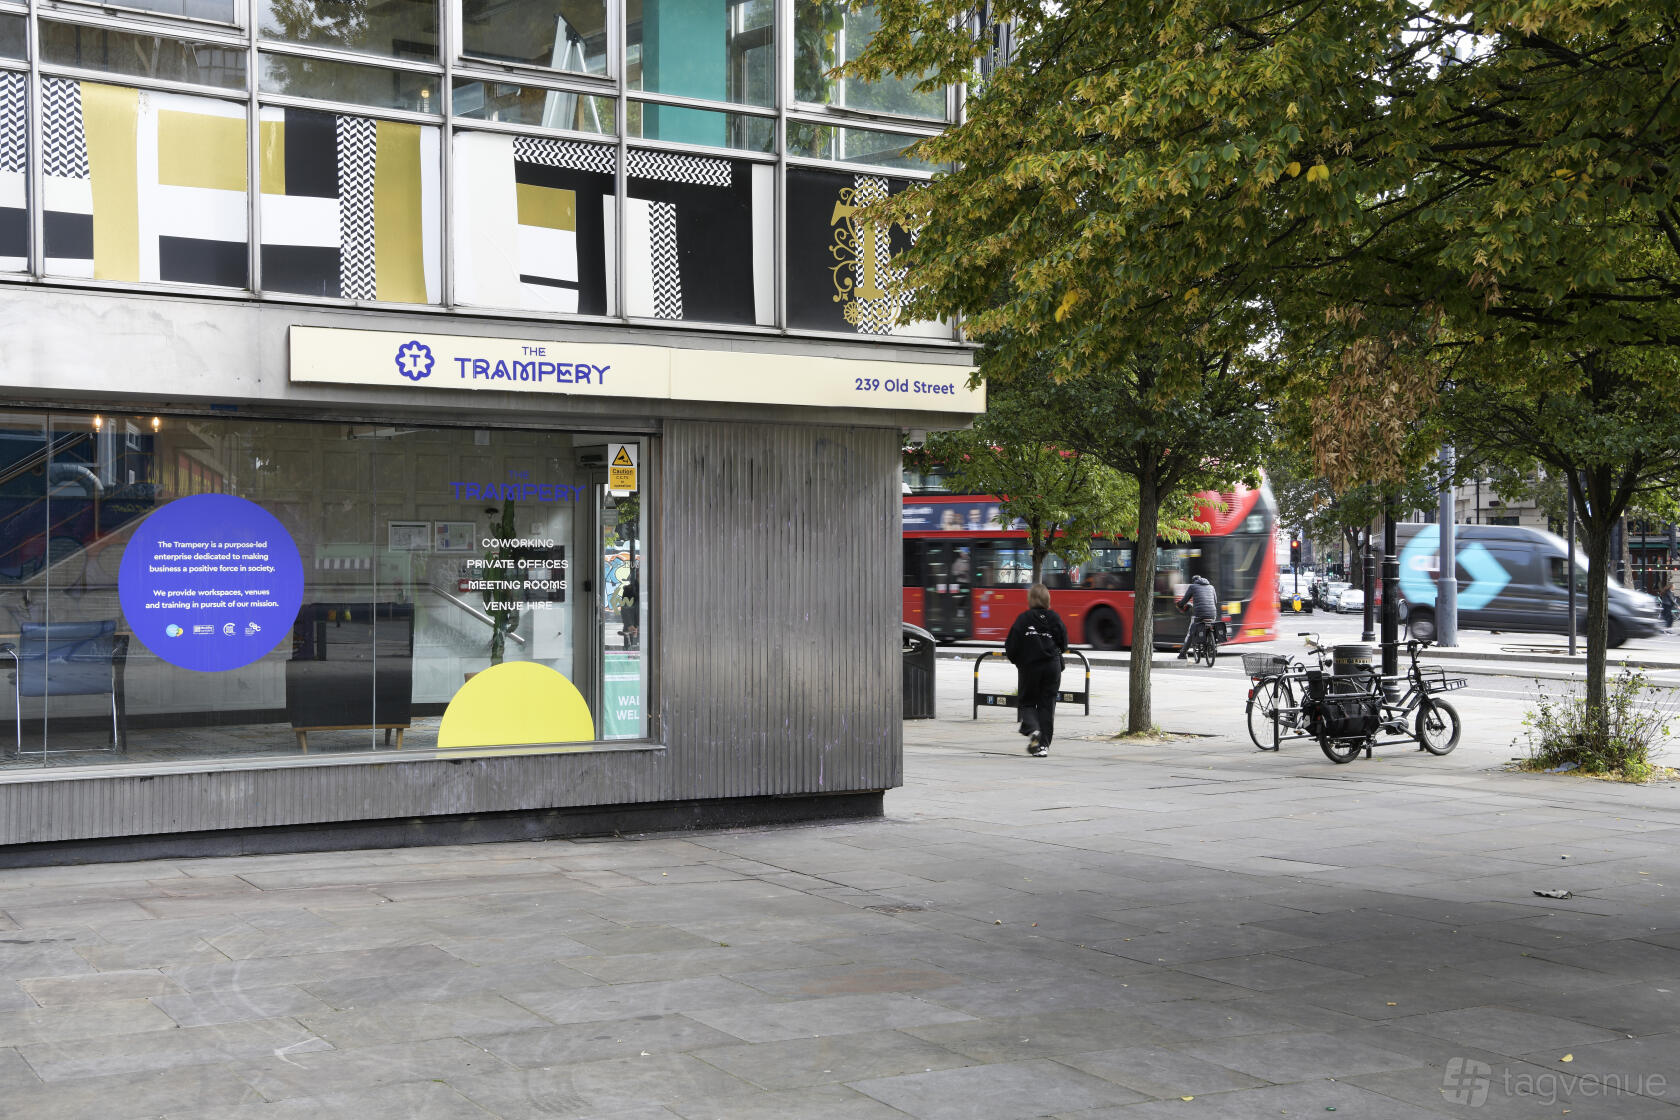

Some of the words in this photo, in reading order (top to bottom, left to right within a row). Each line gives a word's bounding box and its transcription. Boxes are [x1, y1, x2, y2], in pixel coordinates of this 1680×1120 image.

[522, 346, 546, 357] THE
[454, 357, 611, 385] TRAMPERY
[855, 377, 880, 391] 239
[884, 378, 909, 393] Old
[913, 380, 955, 395] Street
[508, 470, 530, 480] THE
[449, 482, 586, 503] TRAMPERY
[173, 541, 209, 550] Trampery
[224, 541, 268, 550] purpose-led
[482, 538, 554, 548] COWORKING
[154, 553, 192, 561] enterprise
[242, 553, 269, 561] making
[189, 565, 218, 573] positive
[248, 565, 276, 573] society.
[467, 560, 515, 569] PRIVATE
[517, 560, 569, 569] OFFICES
[468, 580, 520, 590] MEETING
[523, 580, 568, 590] ROOMS
[153, 589, 166, 597] We
[168, 588, 196, 598] provide
[198, 588, 243, 597] workspaces,
[145, 601, 160, 609] and
[161, 601, 191, 610] training
[200, 600, 227, 609] pursuit
[483, 601, 524, 611] VENUE
[527, 601, 553, 611] HIRE
